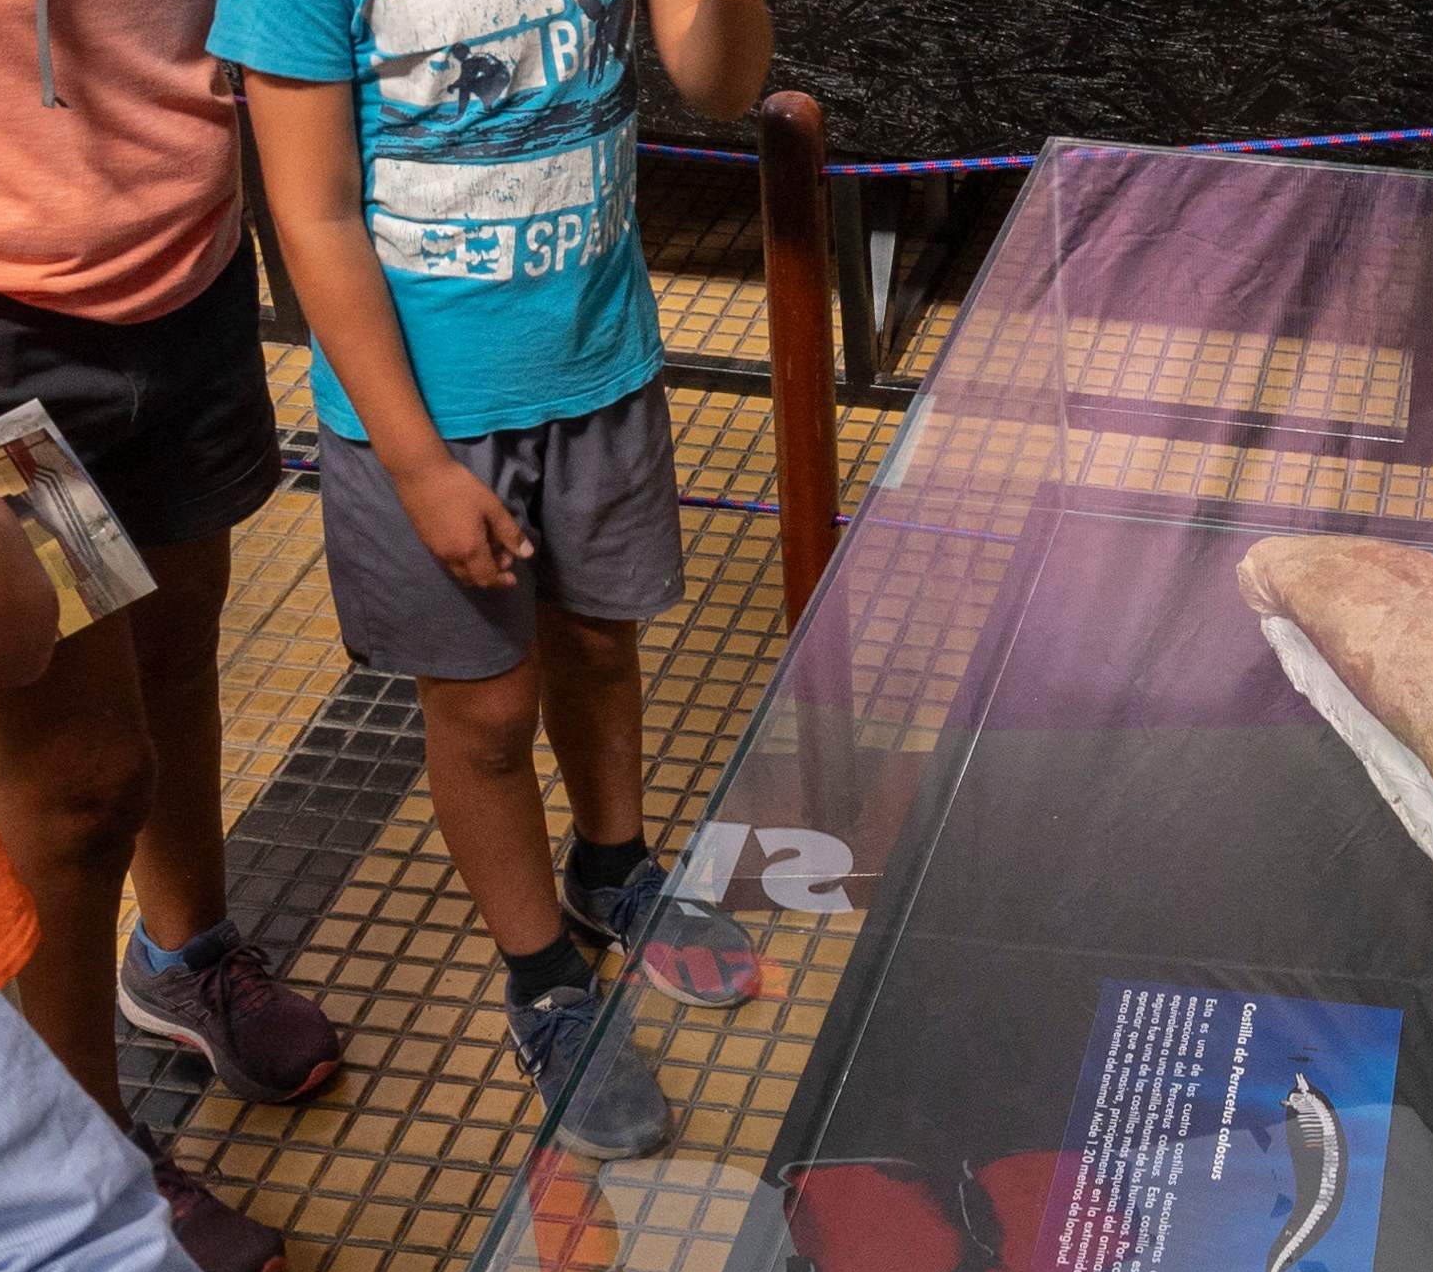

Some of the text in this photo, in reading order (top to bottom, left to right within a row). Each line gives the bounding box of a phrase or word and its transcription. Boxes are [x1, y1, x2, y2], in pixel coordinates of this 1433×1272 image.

[1202, 997, 1218, 1018] Esta
[1198, 1021, 1210, 1034] es
[1193, 1038, 1206, 1059] una
[1189, 1062, 1204, 1077] de
[1185, 1081, 1201, 1098] las
[1209, 1001, 1257, 1180] Costilla de Perucetus colossus
[1177, 1102, 1193, 1137] cuatro
[1166, 1141, 1185, 1186] costillas
[1150, 1191, 1178, 1263] descubiertas
